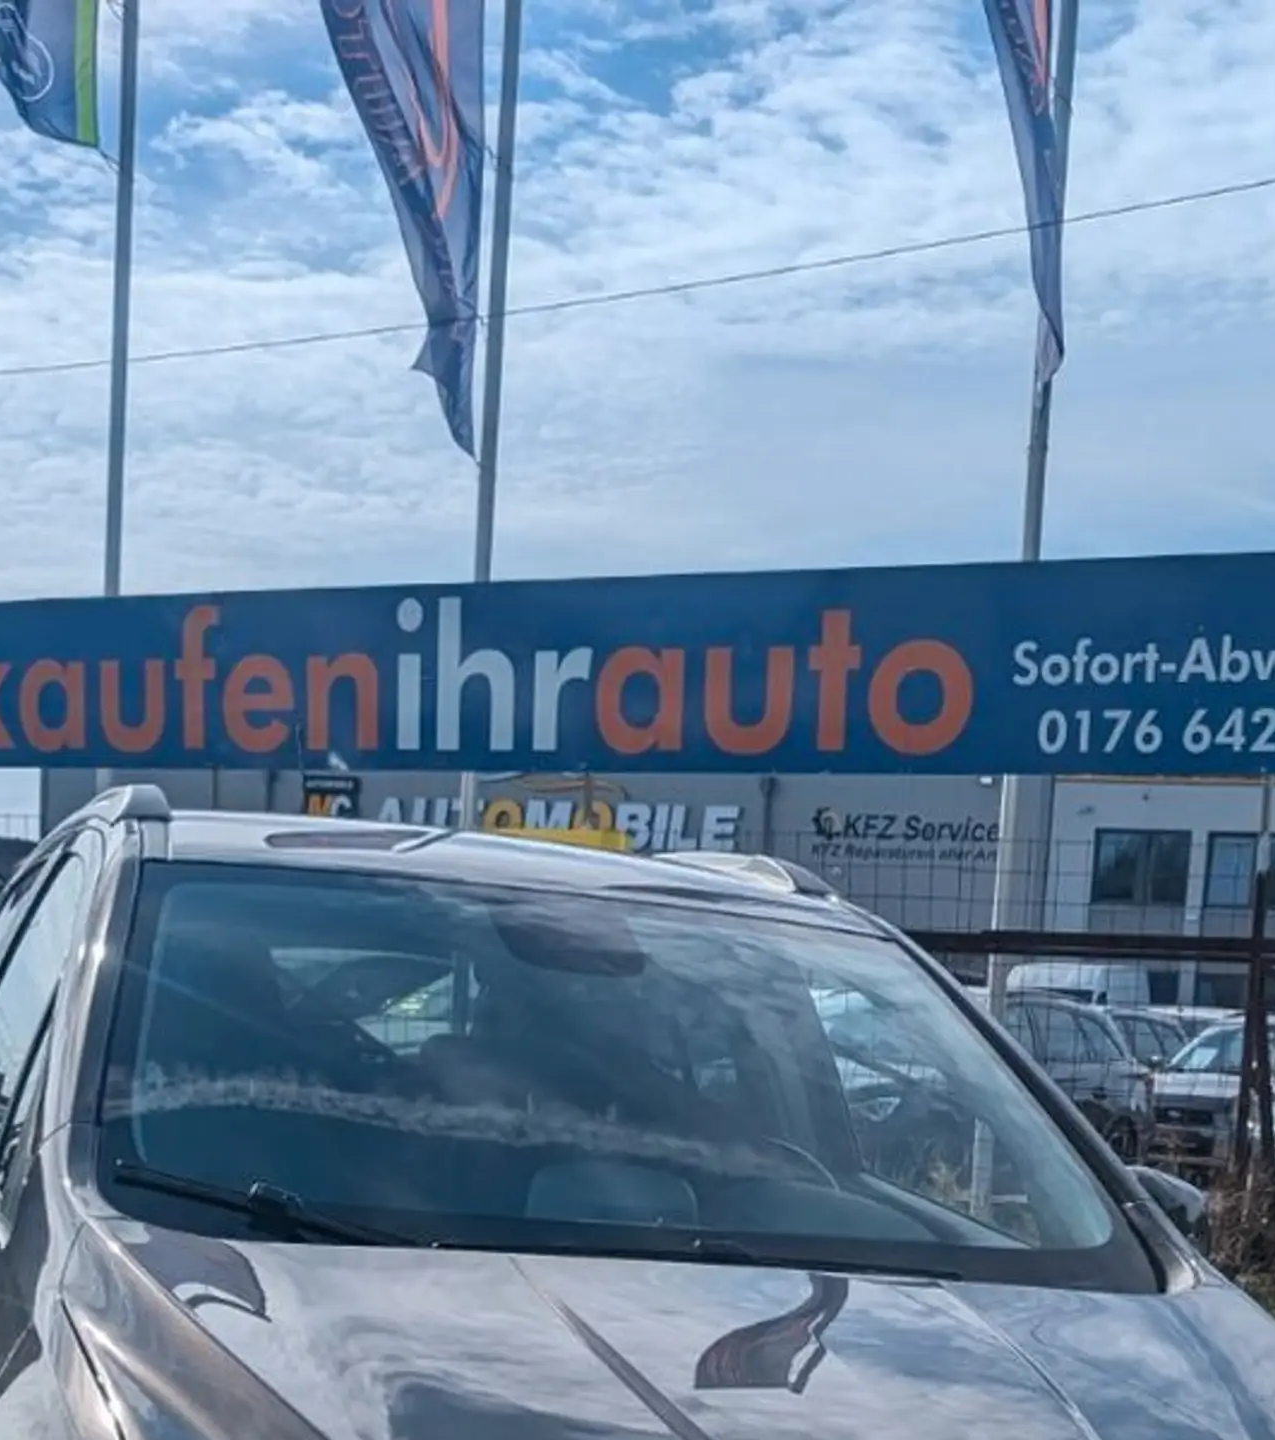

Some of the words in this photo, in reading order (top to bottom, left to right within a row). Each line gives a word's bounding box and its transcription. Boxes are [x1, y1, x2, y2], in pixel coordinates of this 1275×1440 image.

[1038, 709, 1163, 754] 0176
[843, 813, 897, 840] KFZ
[904, 814, 1000, 842] Service
